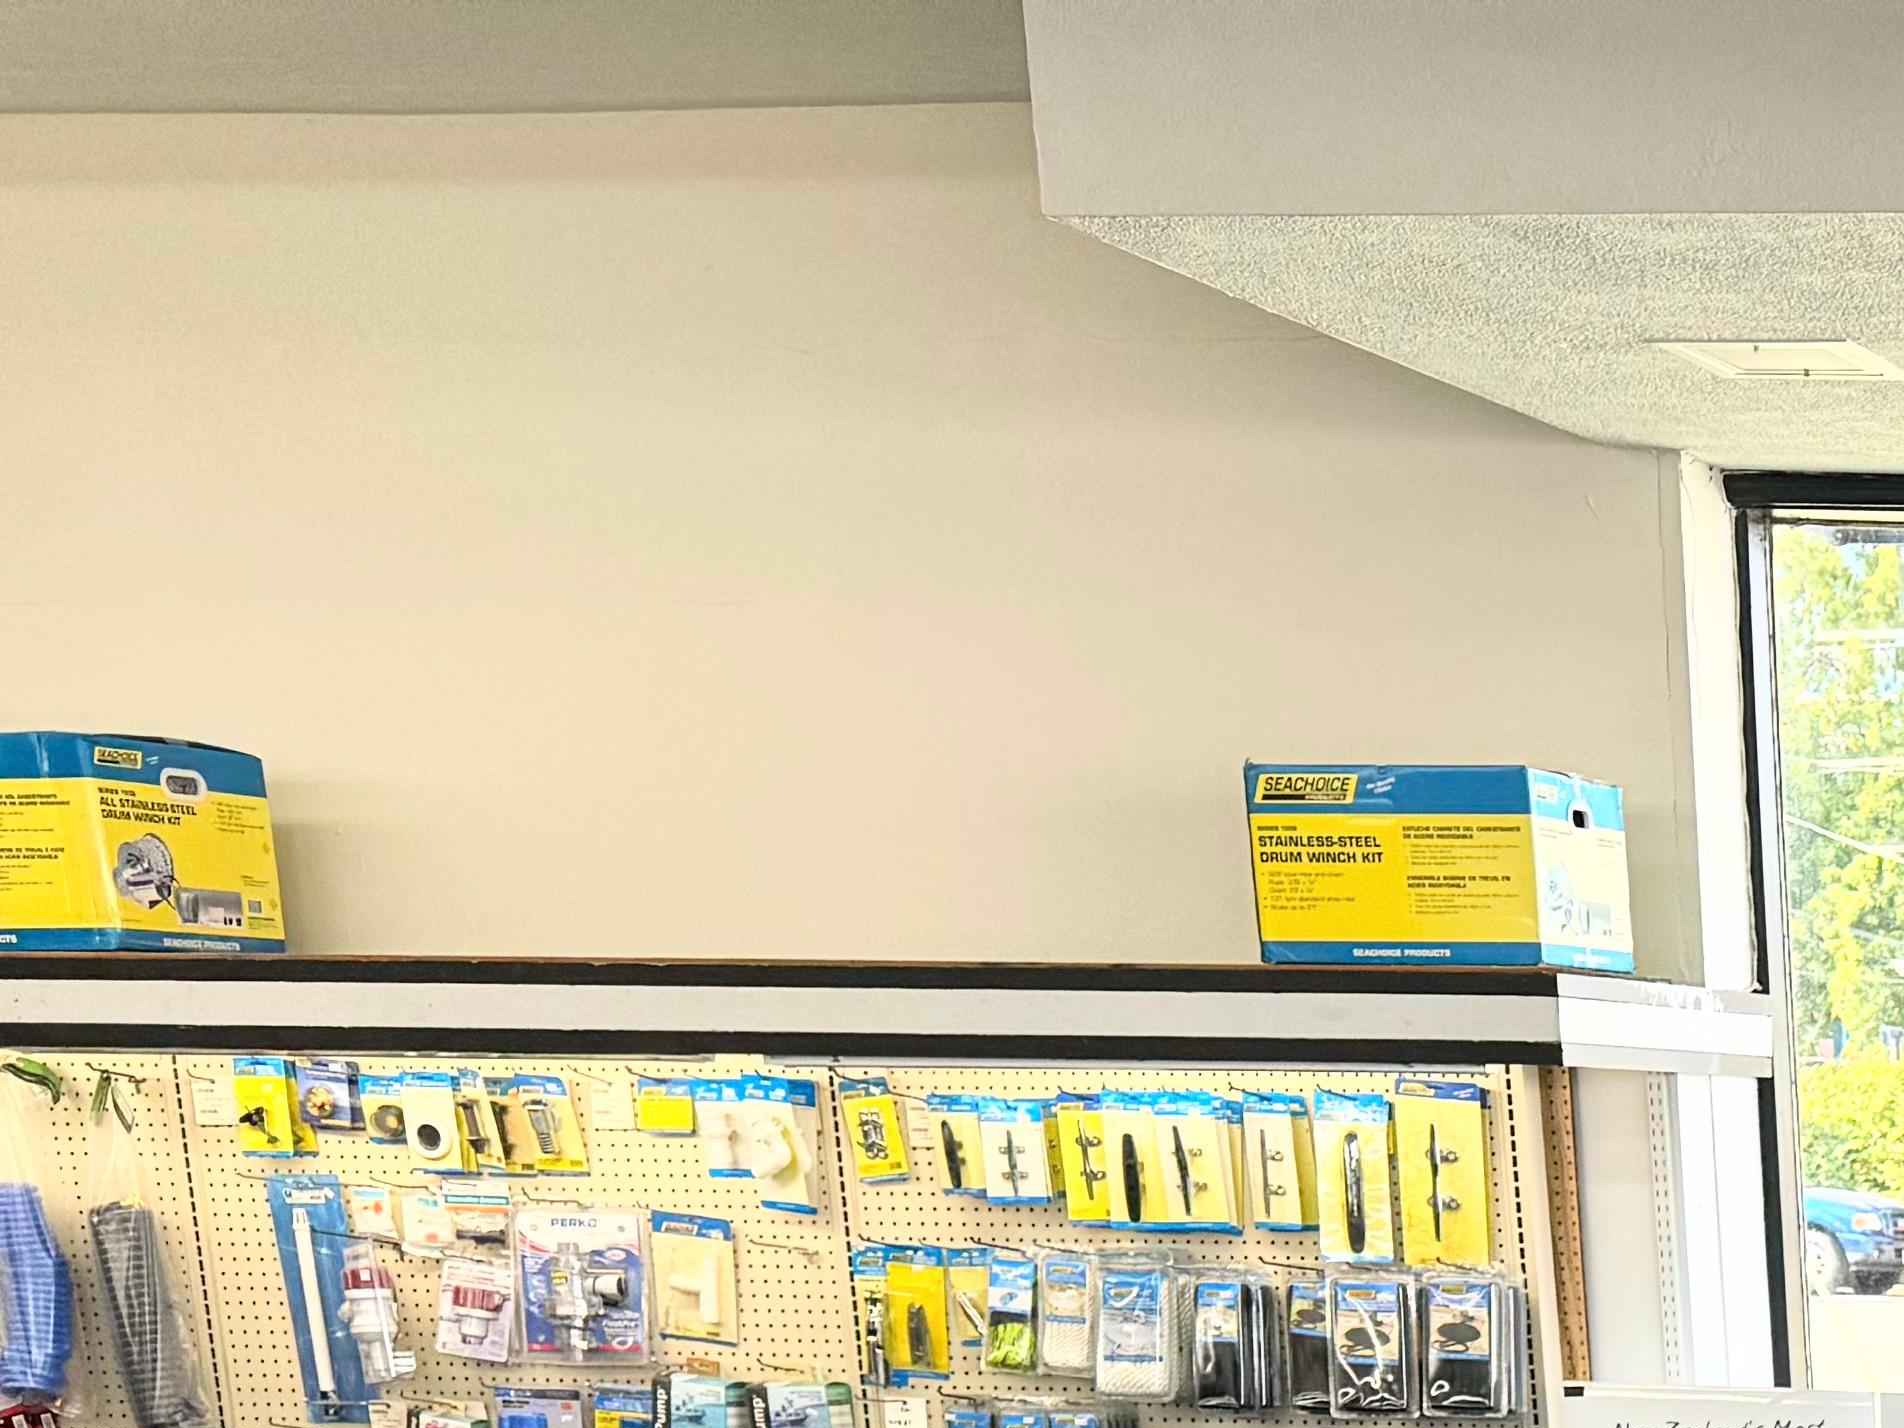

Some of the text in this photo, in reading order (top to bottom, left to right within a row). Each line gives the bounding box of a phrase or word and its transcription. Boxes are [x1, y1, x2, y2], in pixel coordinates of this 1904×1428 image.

[1263, 776, 1352, 792] SEACHOICE
[1258, 835, 1381, 848] STAINLESS-STEEL
[1260, 851, 1384, 864] DRUM WINCH KIT
